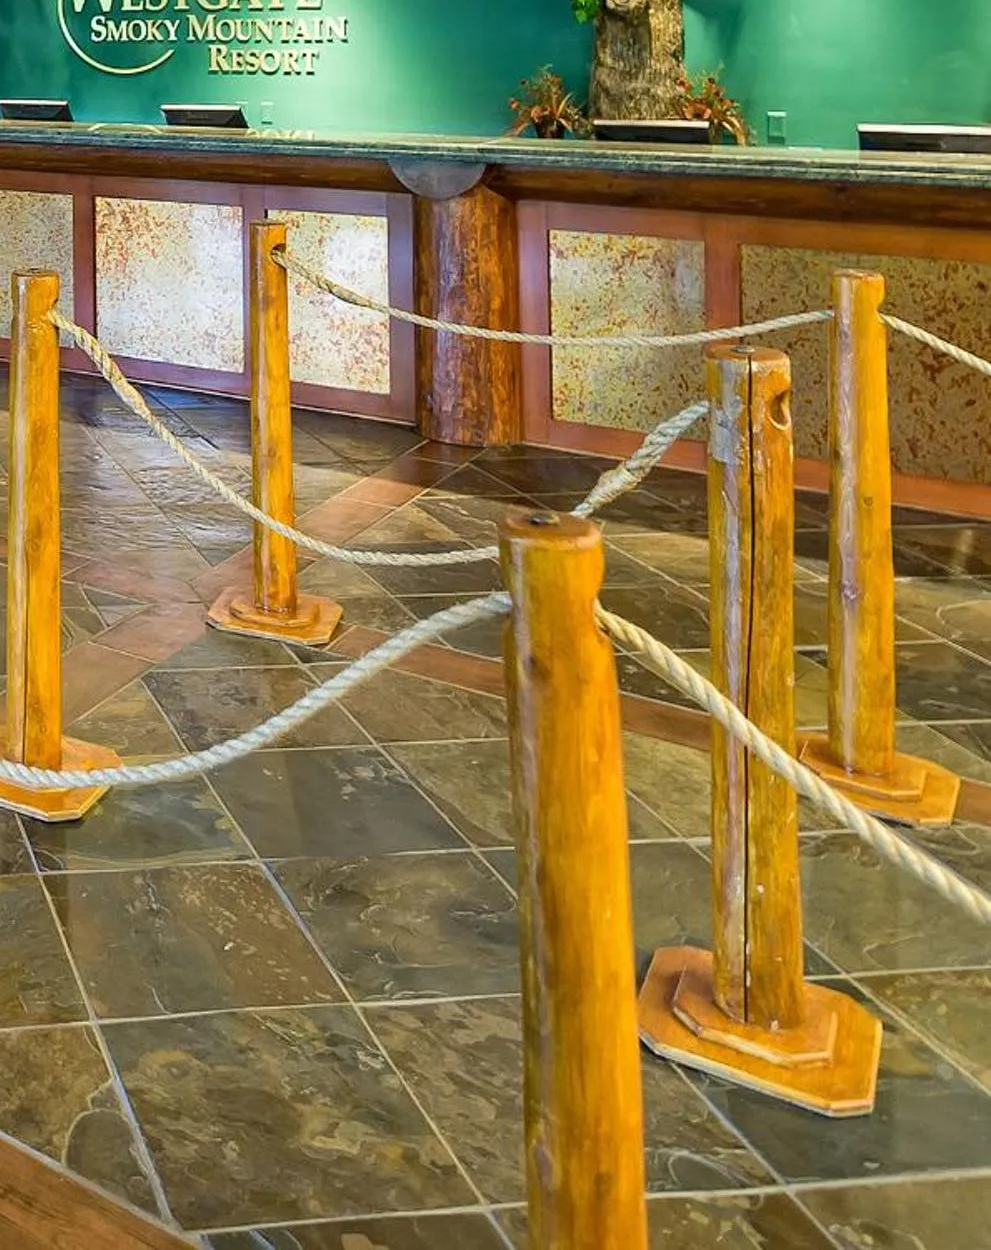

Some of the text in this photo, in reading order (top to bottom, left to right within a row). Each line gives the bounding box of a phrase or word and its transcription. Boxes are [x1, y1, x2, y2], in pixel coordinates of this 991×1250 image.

[91, 14, 349, 42] SMOKY MOUNTAIN
[208, 45, 319, 74] RESORT
